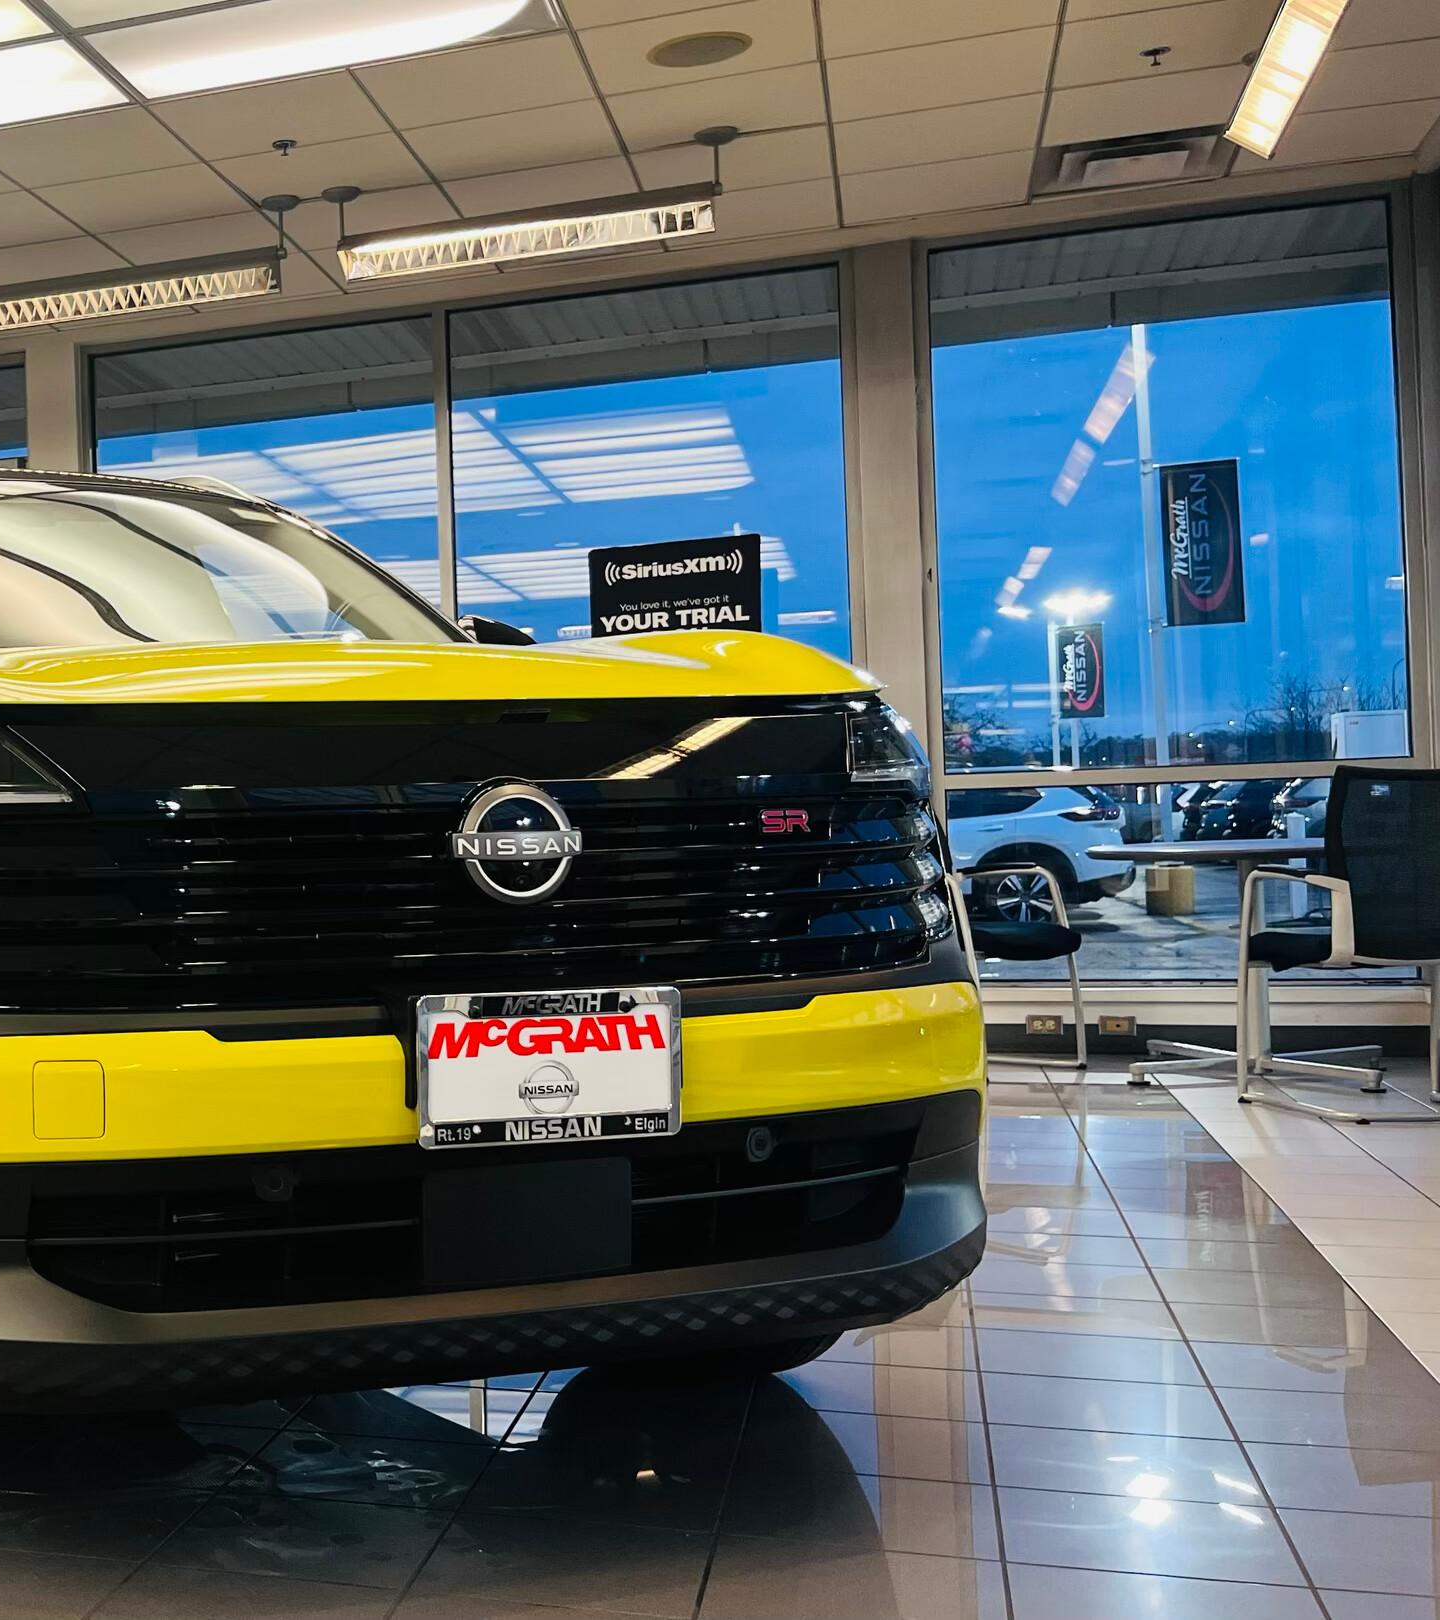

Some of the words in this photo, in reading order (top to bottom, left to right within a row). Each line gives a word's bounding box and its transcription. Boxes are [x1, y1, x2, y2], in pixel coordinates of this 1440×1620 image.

[1189, 473, 1213, 595] NISSAN
[619, 603, 638, 612] You
[640, 601, 660, 610] love
[662, 600, 670, 609] it,
[673, 598, 701, 608] we've
[703, 596, 720, 606] got
[722, 595, 729, 603] it
[600, 612, 670, 633] YOUR
[675, 605, 750, 626] TRIAL
[1074, 630, 1087, 701] NISSAN
[761, 809, 810, 833] SR
[457, 835, 581, 856] NISSAN
[524, 1083, 574, 1095] NISSAN
[505, 1117, 602, 1141] NISSAN
[635, 1116, 666, 1132] Elgin
